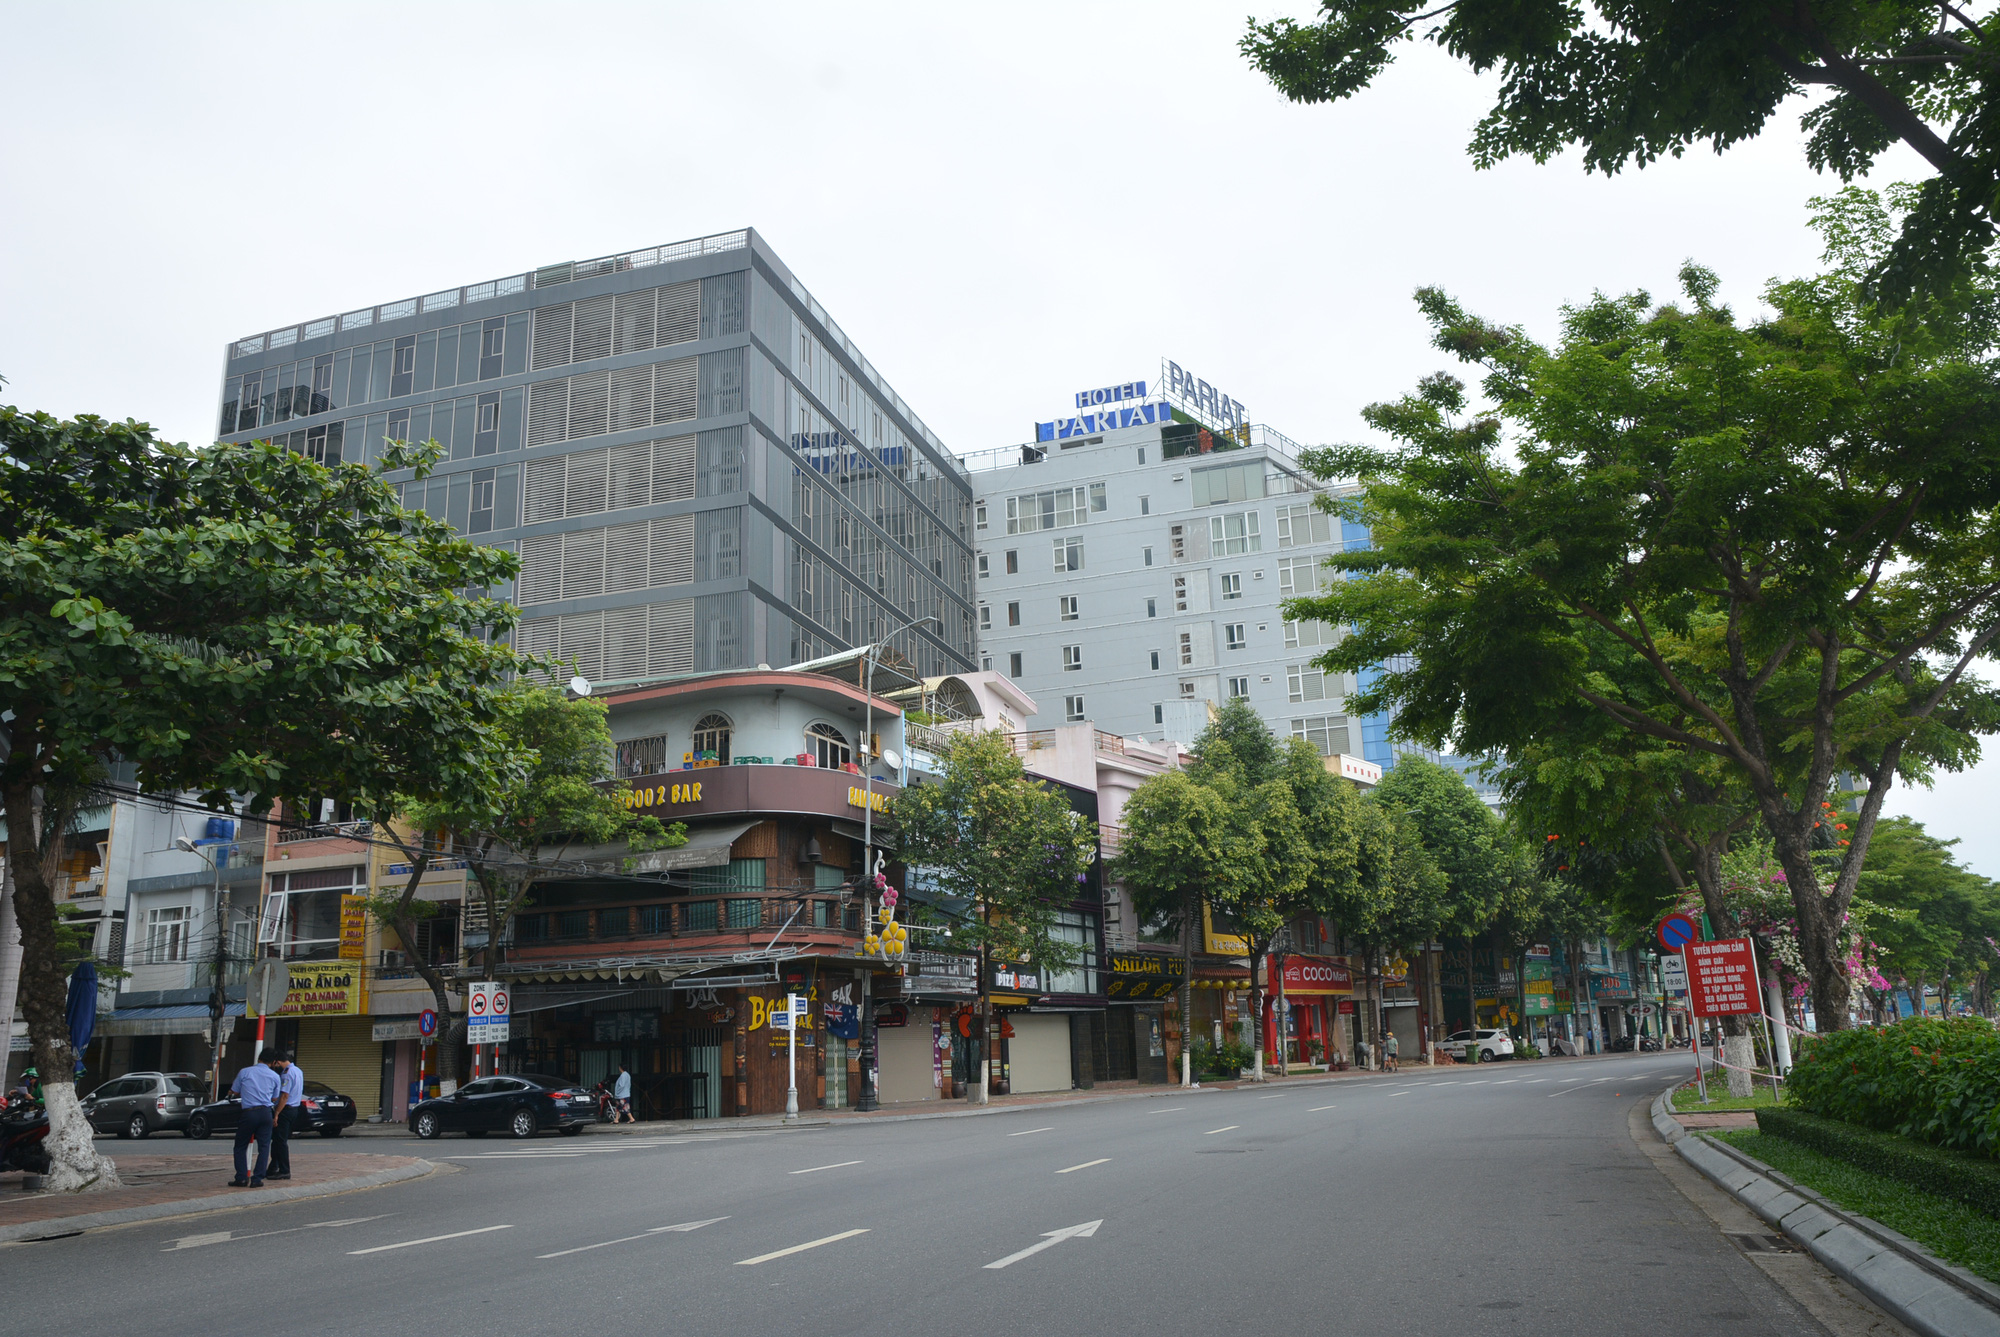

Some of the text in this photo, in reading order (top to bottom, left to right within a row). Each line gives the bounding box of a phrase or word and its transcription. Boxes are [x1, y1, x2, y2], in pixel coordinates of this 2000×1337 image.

[1078, 382, 1142, 406] HOTEL
[1168, 360, 1245, 434] PARIAT
[1053, 401, 1165, 440] PARIAT
[656, 785, 666, 806] 2
[671, 782, 702, 804] BAR
[1693, 943, 1711, 955] TUYẾN
[1113, 956, 1187, 975] SAILOR PU
[1438, 948, 1490, 970] PARAT
[1303, 966, 1349, 982] COCO Mart
[1601, 976, 1621, 989] 196
[473, 984, 486, 992] ZONE
[494, 983, 506, 991] ZONE
[832, 983, 853, 1005] BAR
[1555, 989, 1571, 1002] 198
